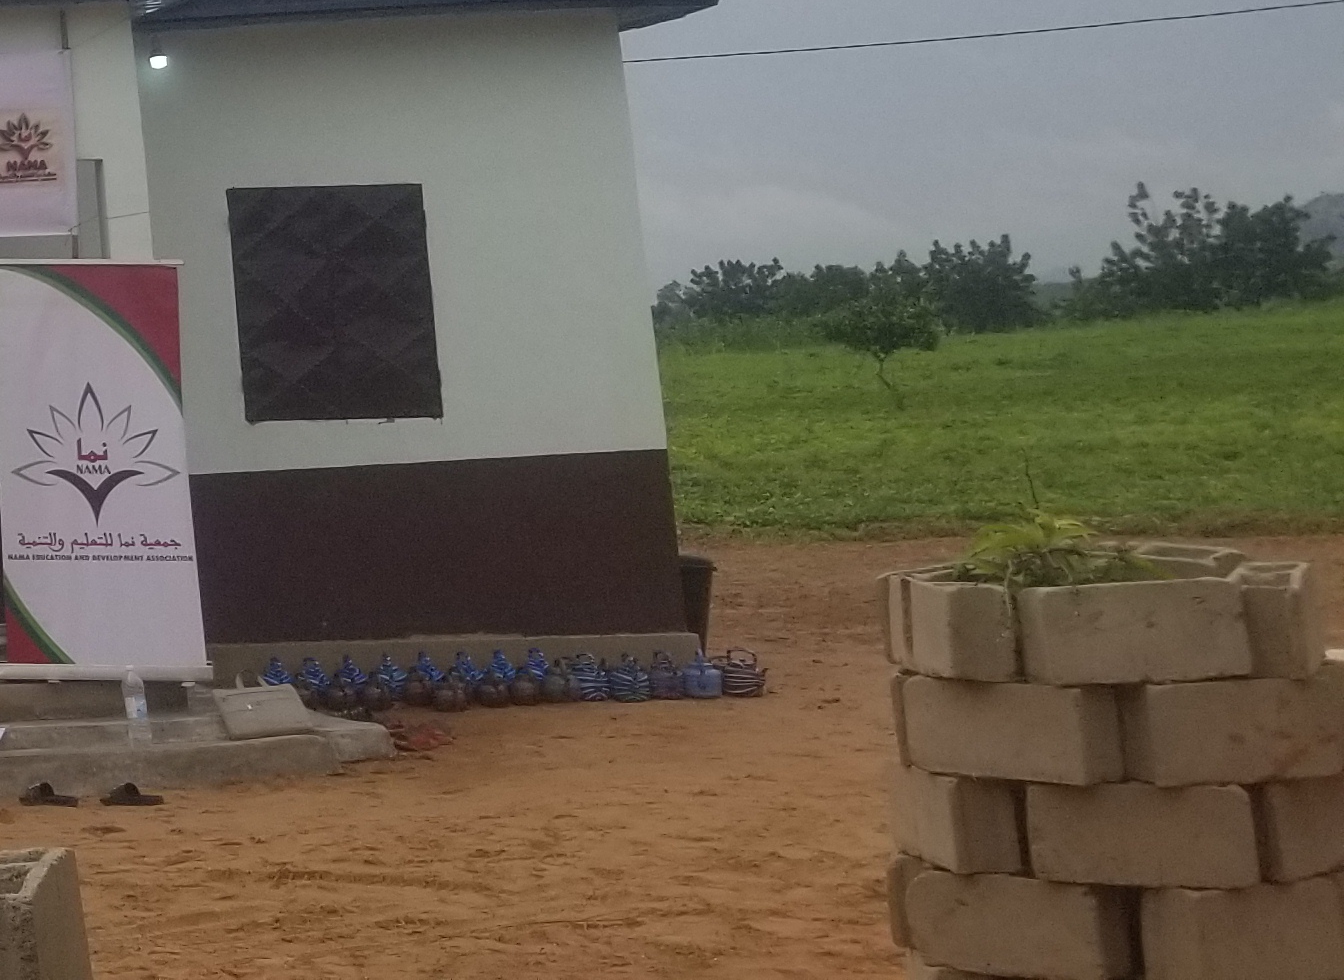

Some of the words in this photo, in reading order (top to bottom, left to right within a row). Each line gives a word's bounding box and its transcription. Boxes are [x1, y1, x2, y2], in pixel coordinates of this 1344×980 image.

[6, 159, 48, 173] NAMA
[76, 437, 109, 463] نما
[76, 463, 112, 475] NAMA
[17, 531, 65, 552] والتنمية
[70, 532, 114, 554] للتعليم
[117, 532, 136, 548] نما
[139, 533, 182, 550] جمعية
[32, 553, 73, 561] EDUCATION
[92, 554, 144, 562] DEVELOPMENT
[146, 554, 194, 562] ASSOCIATION
